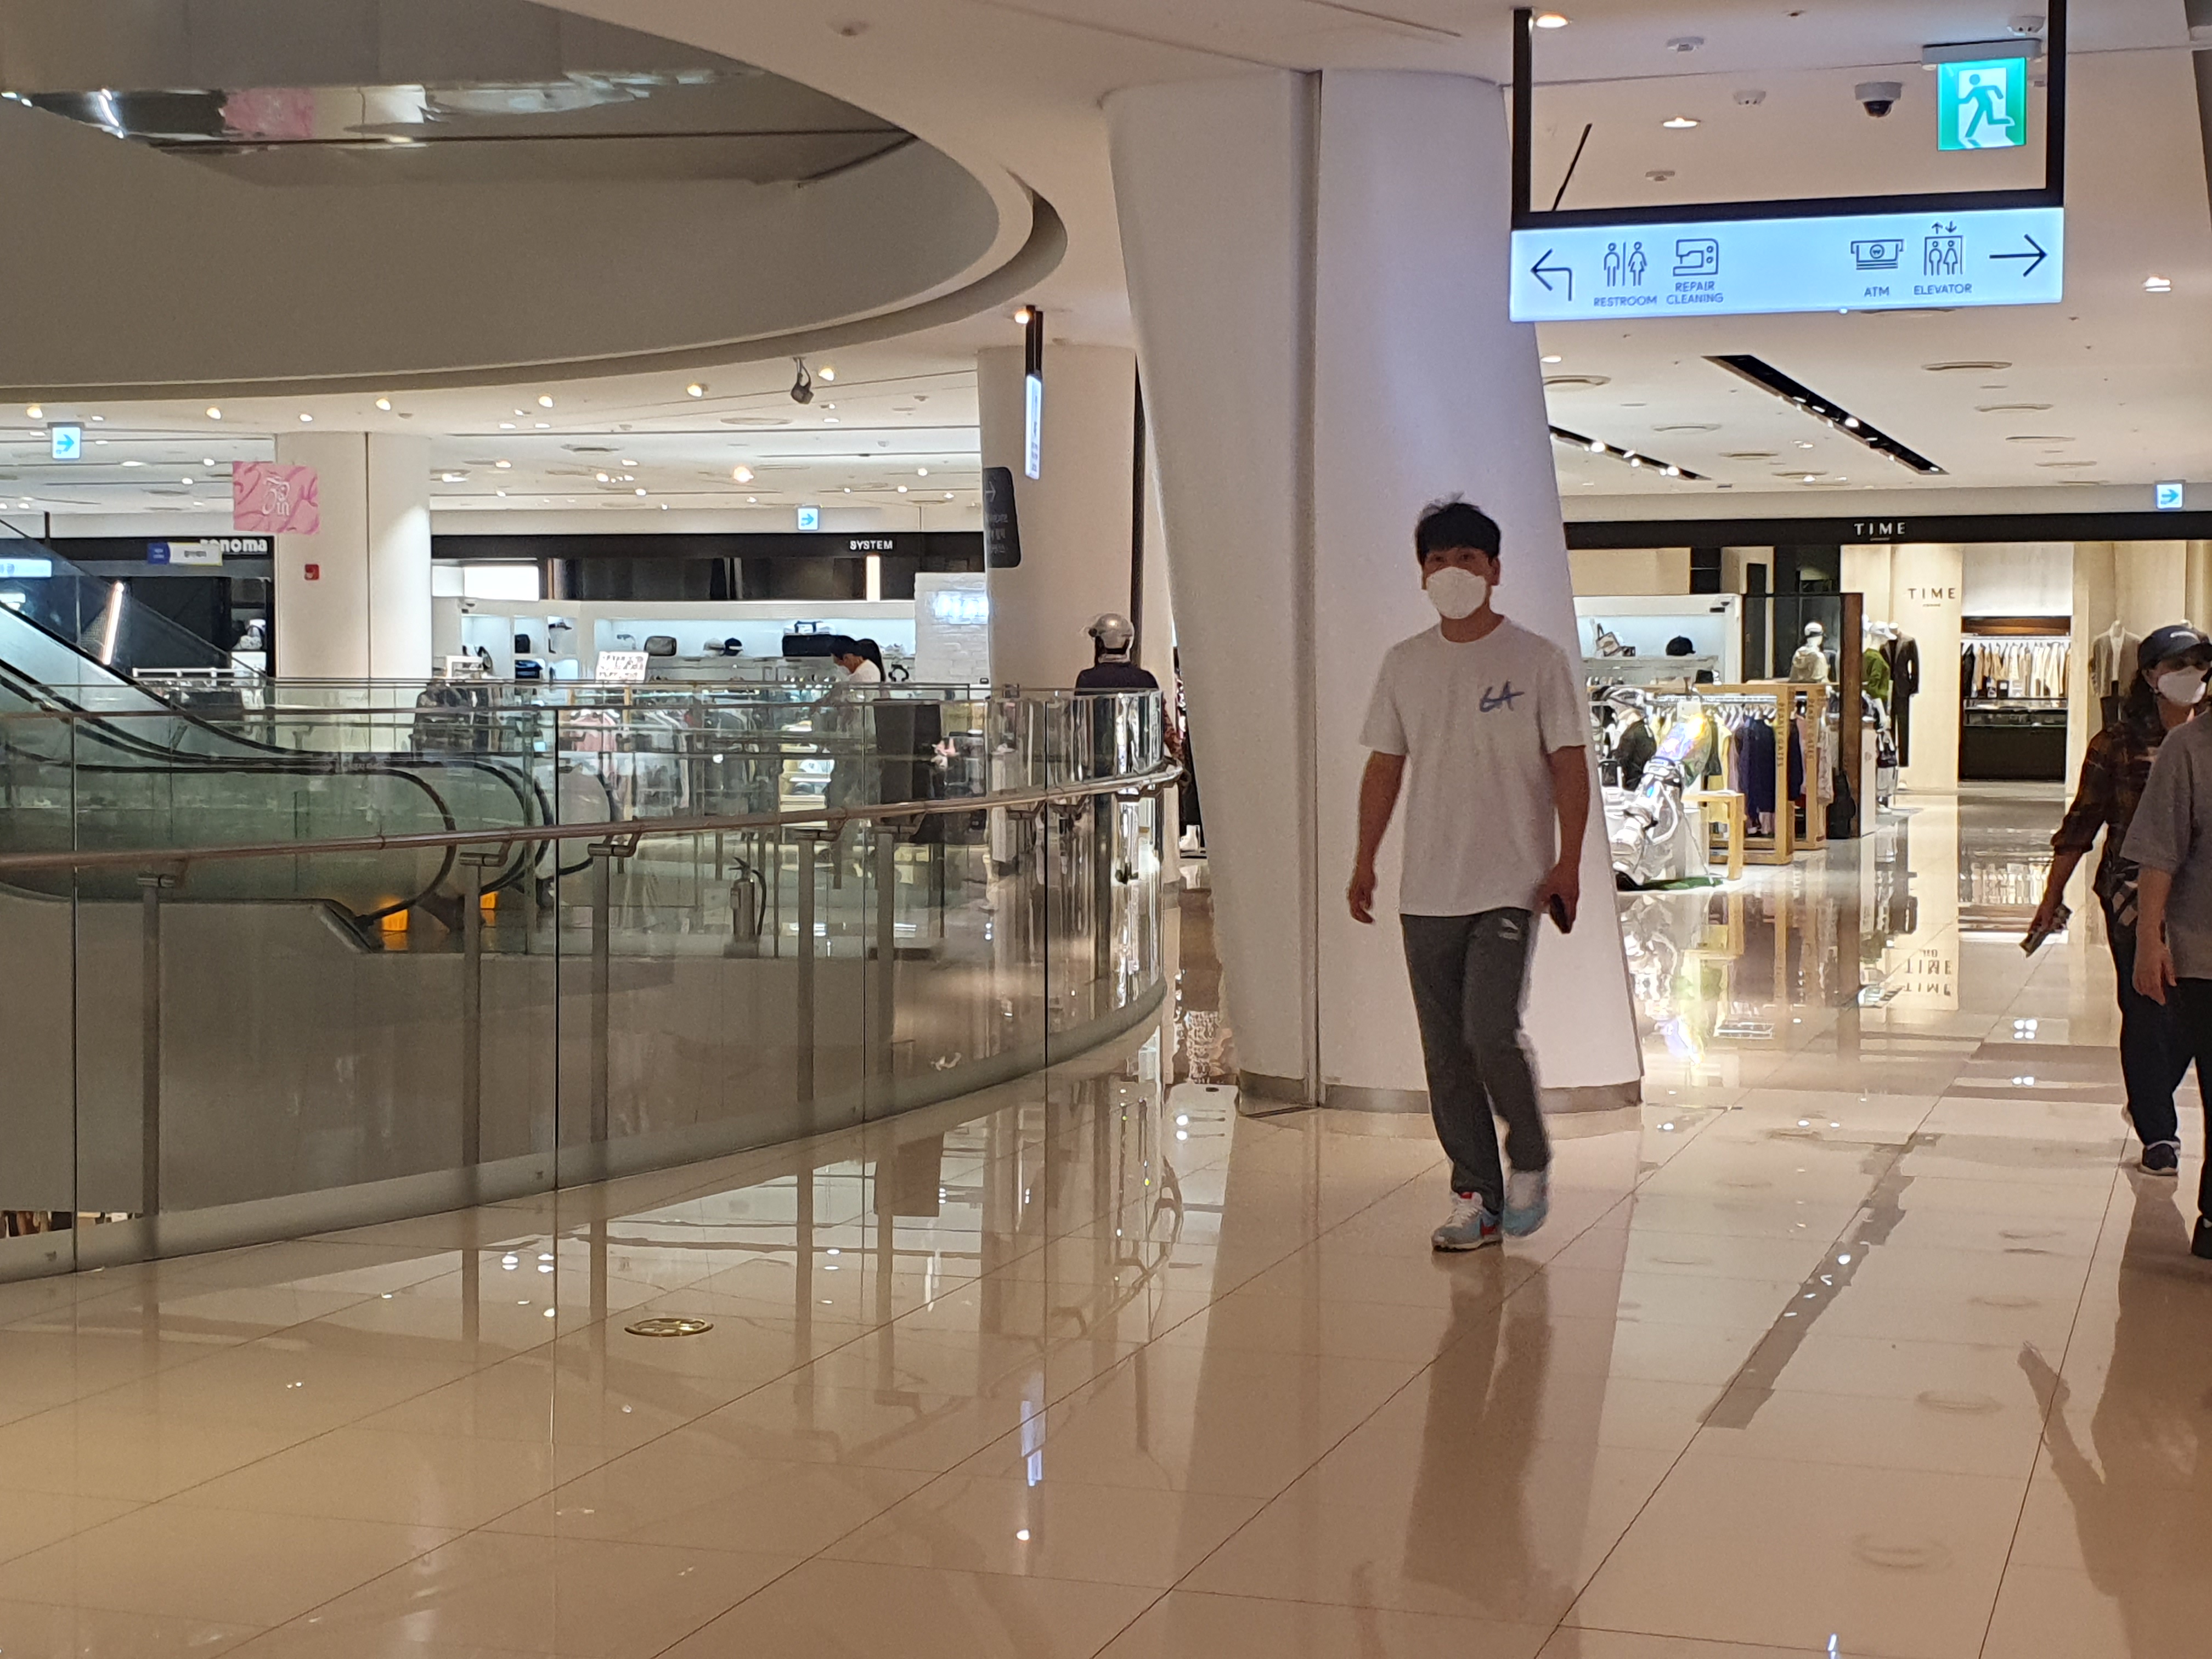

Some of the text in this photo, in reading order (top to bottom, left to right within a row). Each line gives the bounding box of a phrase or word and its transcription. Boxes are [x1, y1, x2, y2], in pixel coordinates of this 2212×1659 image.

[1675, 281, 1715, 292] REPAIR
[1864, 286, 1890, 297] ATM
[1914, 283, 1972, 295] ELEVATOR
[1593, 295, 1657, 307] RESTROOM
[1666, 292, 1724, 304] CLEANING
[1853, 522, 1906, 536] TIME
[849, 540, 893, 550] SYSTEM
[1907, 588, 1956, 599] TIME
